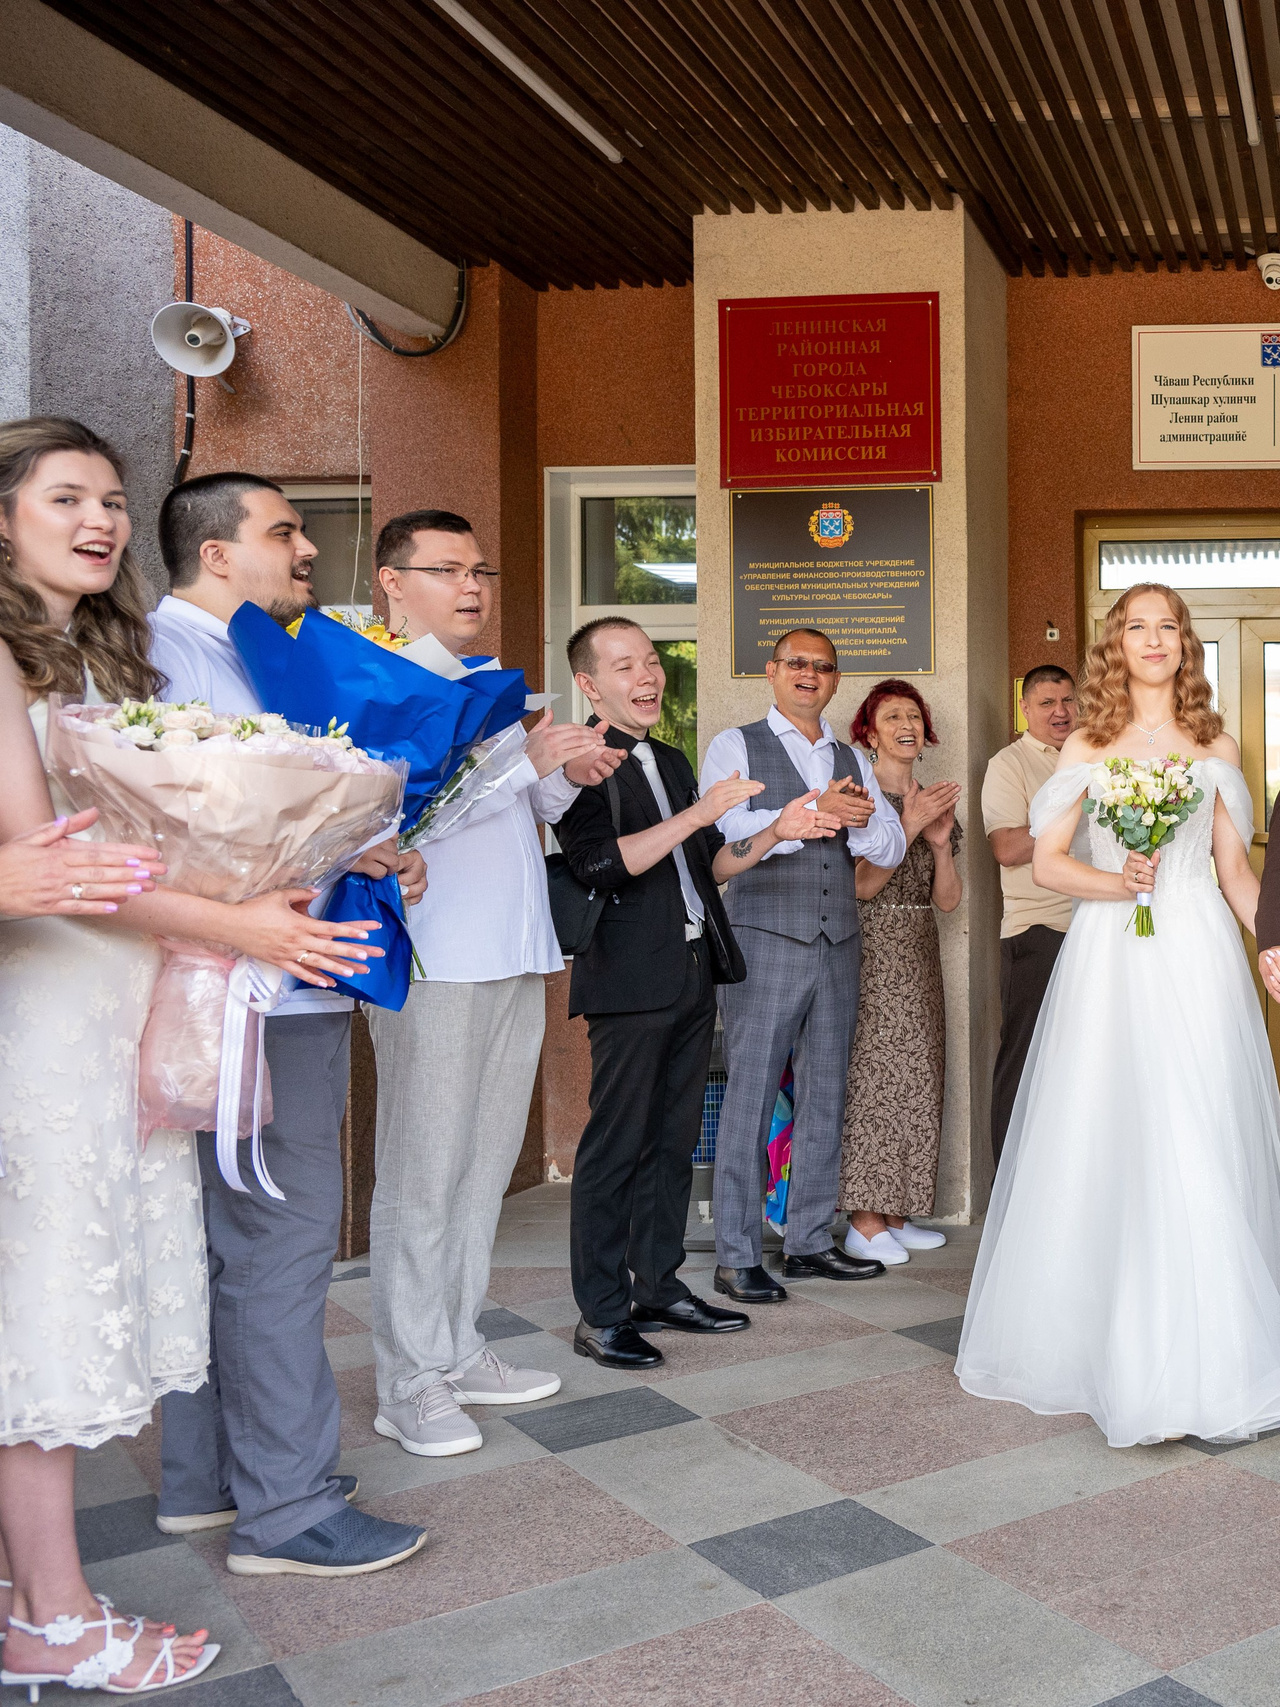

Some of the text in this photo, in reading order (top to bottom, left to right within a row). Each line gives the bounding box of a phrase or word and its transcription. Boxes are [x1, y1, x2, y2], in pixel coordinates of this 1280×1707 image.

[769, 319, 886, 335] ЛЕНИНСКАЯ
[777, 340, 880, 356] РАЙОННАЯ
[793, 362, 867, 377] ГОРОДА
[1193, 374, 1254, 388] Республики
[772, 382, 887, 399] ЧЕБОКСАРЫ
[1151, 394, 1256, 408] Шупашкар хулинчи
[736, 402, 924, 421] ТЕРРИТОРИАЛЬНАЯ
[1170, 412, 1238, 425] Ленин район
[750, 424, 911, 442] ИЗБИРАТЕЛЬНАЯ
[775, 446, 886, 462] КОМИССИЯ
[816, 561, 863, 569] БЮДЖЕТНОЕ
[739, 570, 925, 580] «УПРАВЛЕНИЕ ФИНАНСОВО-ПРОИЗВОДСТВЕННОГО
[745, 580, 919, 591] ОБЕСПЕЧЕНИЯ МУНИЦИПАЛЬНЫХ УЧРЕЖДЕНИЙ
[843, 592, 892, 600] ЧЕБОКСАРЫ»
[817, 617, 848, 625] БЮДЖЕТ
